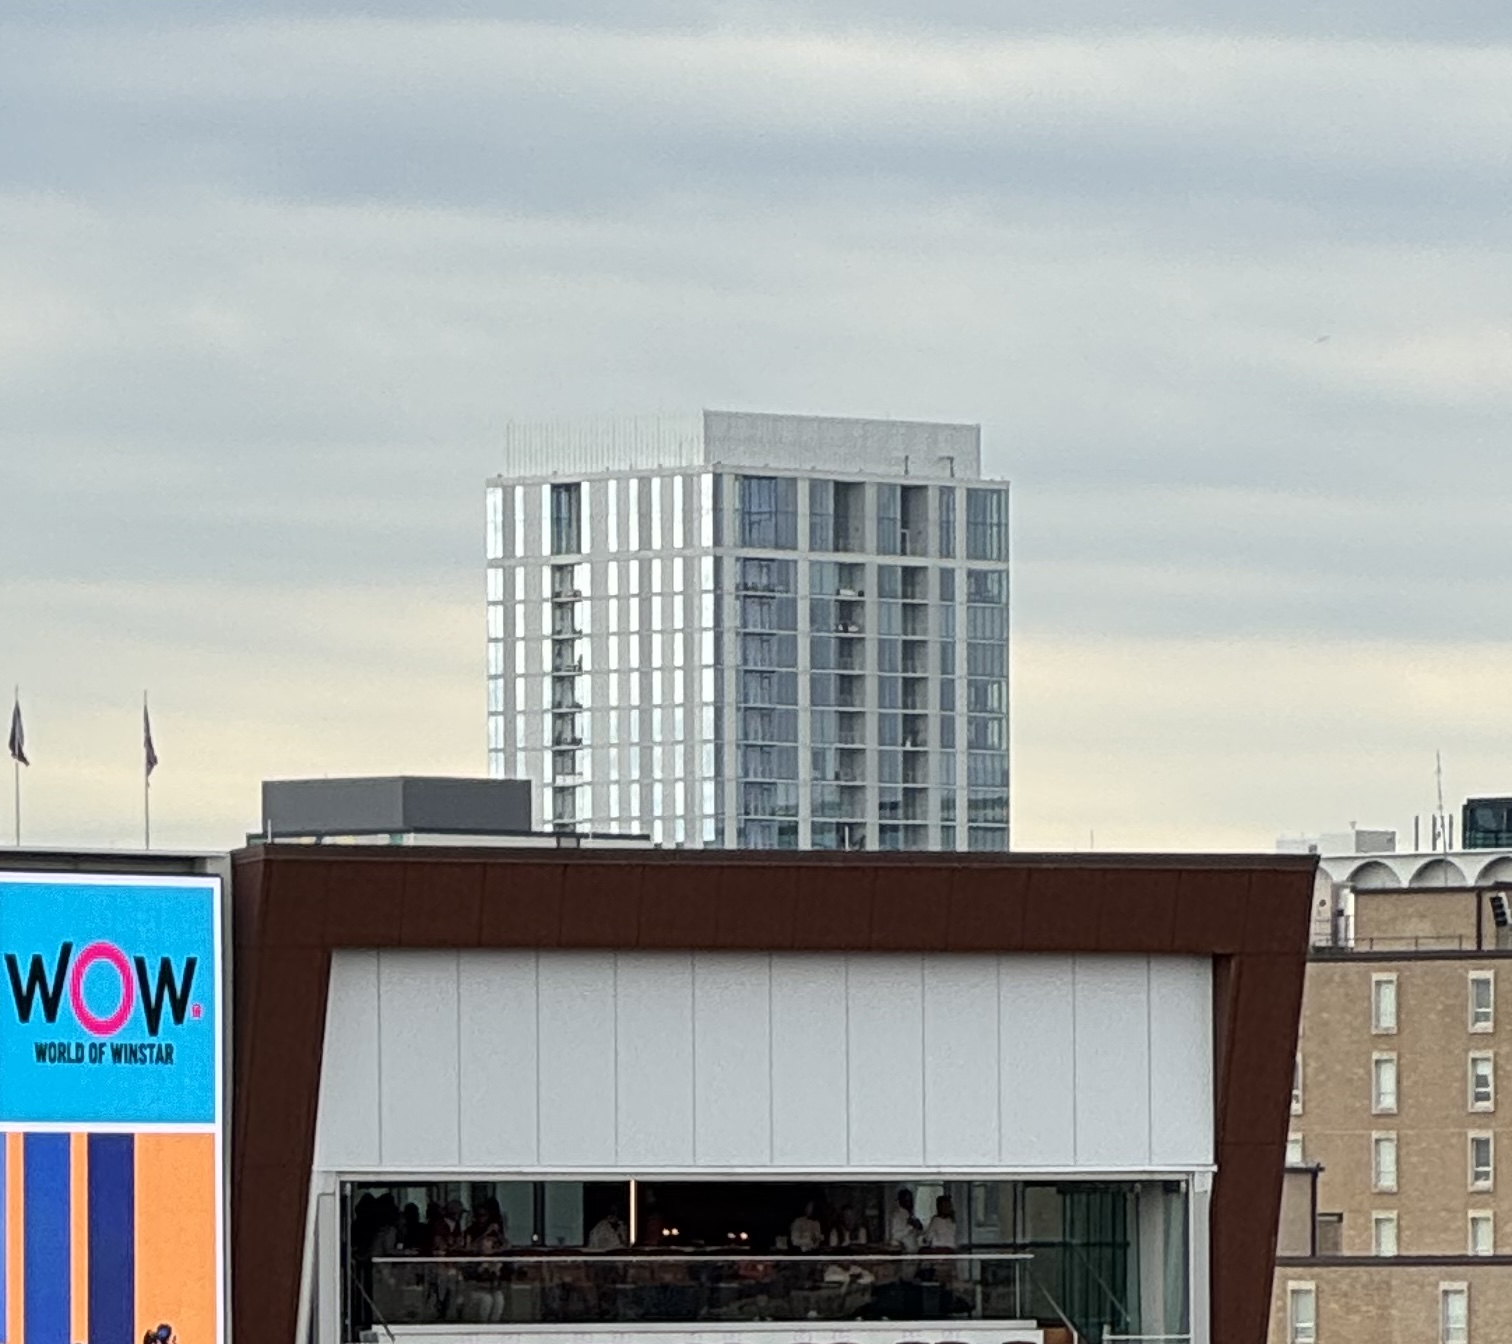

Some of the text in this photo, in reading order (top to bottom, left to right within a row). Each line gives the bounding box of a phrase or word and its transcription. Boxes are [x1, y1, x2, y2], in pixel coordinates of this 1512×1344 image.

[3, 941, 198, 1038] WOW
[34, 1041, 174, 1066] WORLD OF WINSTAR
